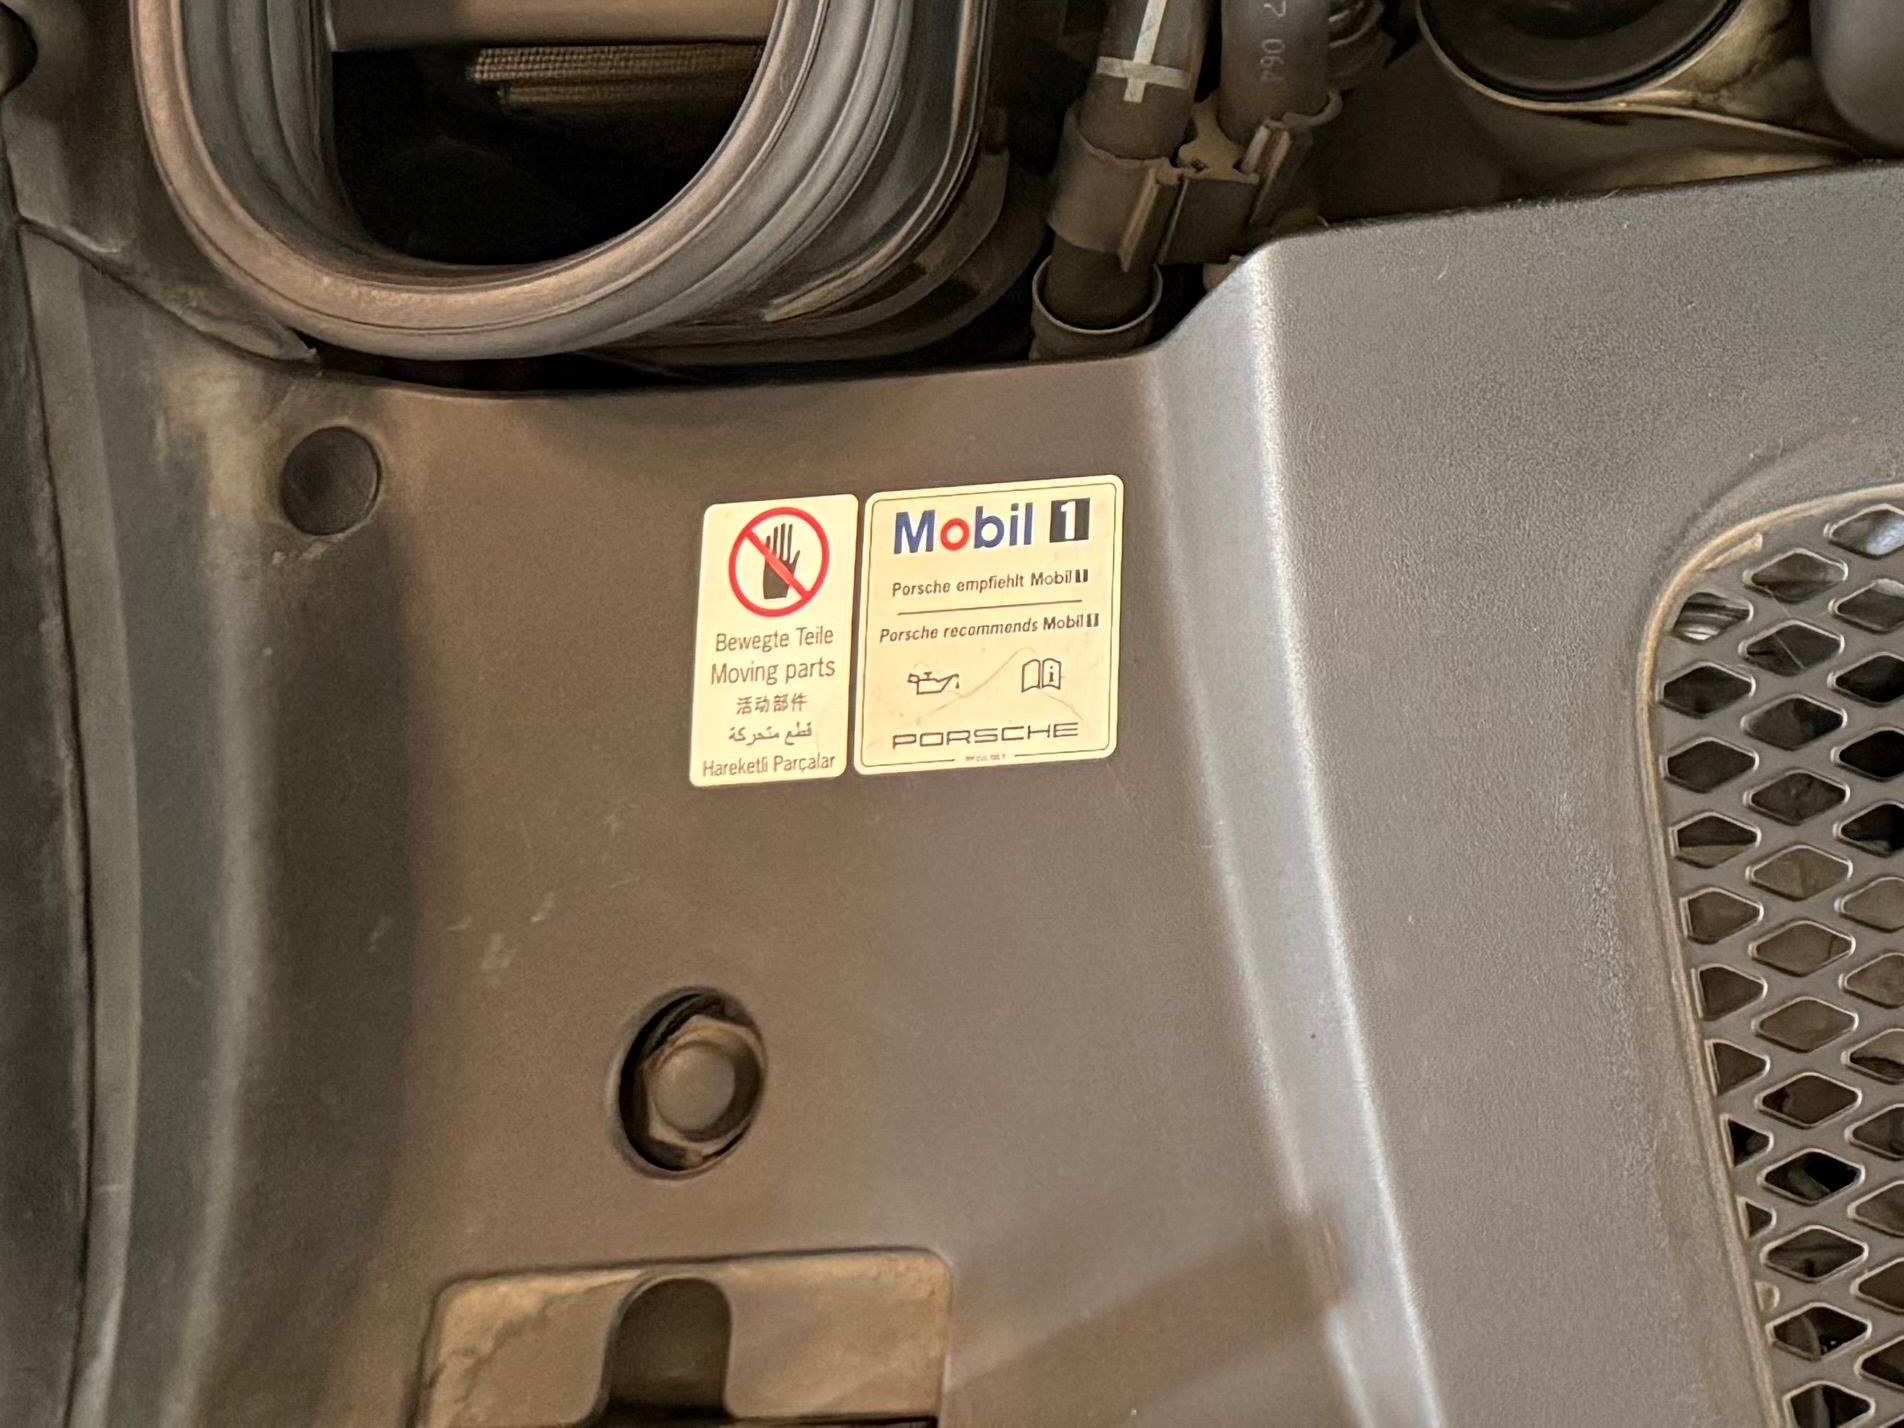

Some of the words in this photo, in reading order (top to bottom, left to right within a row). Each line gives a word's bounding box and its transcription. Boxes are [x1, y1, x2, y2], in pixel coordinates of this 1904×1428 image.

[893, 502, 1034, 555] Mobil
[892, 580, 951, 597] Porsche
[956, 573, 1024, 594] empfiehlt
[1031, 570, 1072, 587] Mobil
[715, 630, 790, 653] Bewegte
[795, 625, 834, 647] Teile
[879, 626, 938, 643] Porsche
[943, 618, 1038, 639] recommends
[1043, 614, 1084, 631] Mobil
[710, 660, 778, 686] Moving
[785, 657, 836, 684] parts
[736, 692, 808, 715] 活动部件
[892, 722, 1079, 750] PORSCHE
[702, 756, 769, 777] Hareketli
[773, 752, 836, 773] Parçalar
